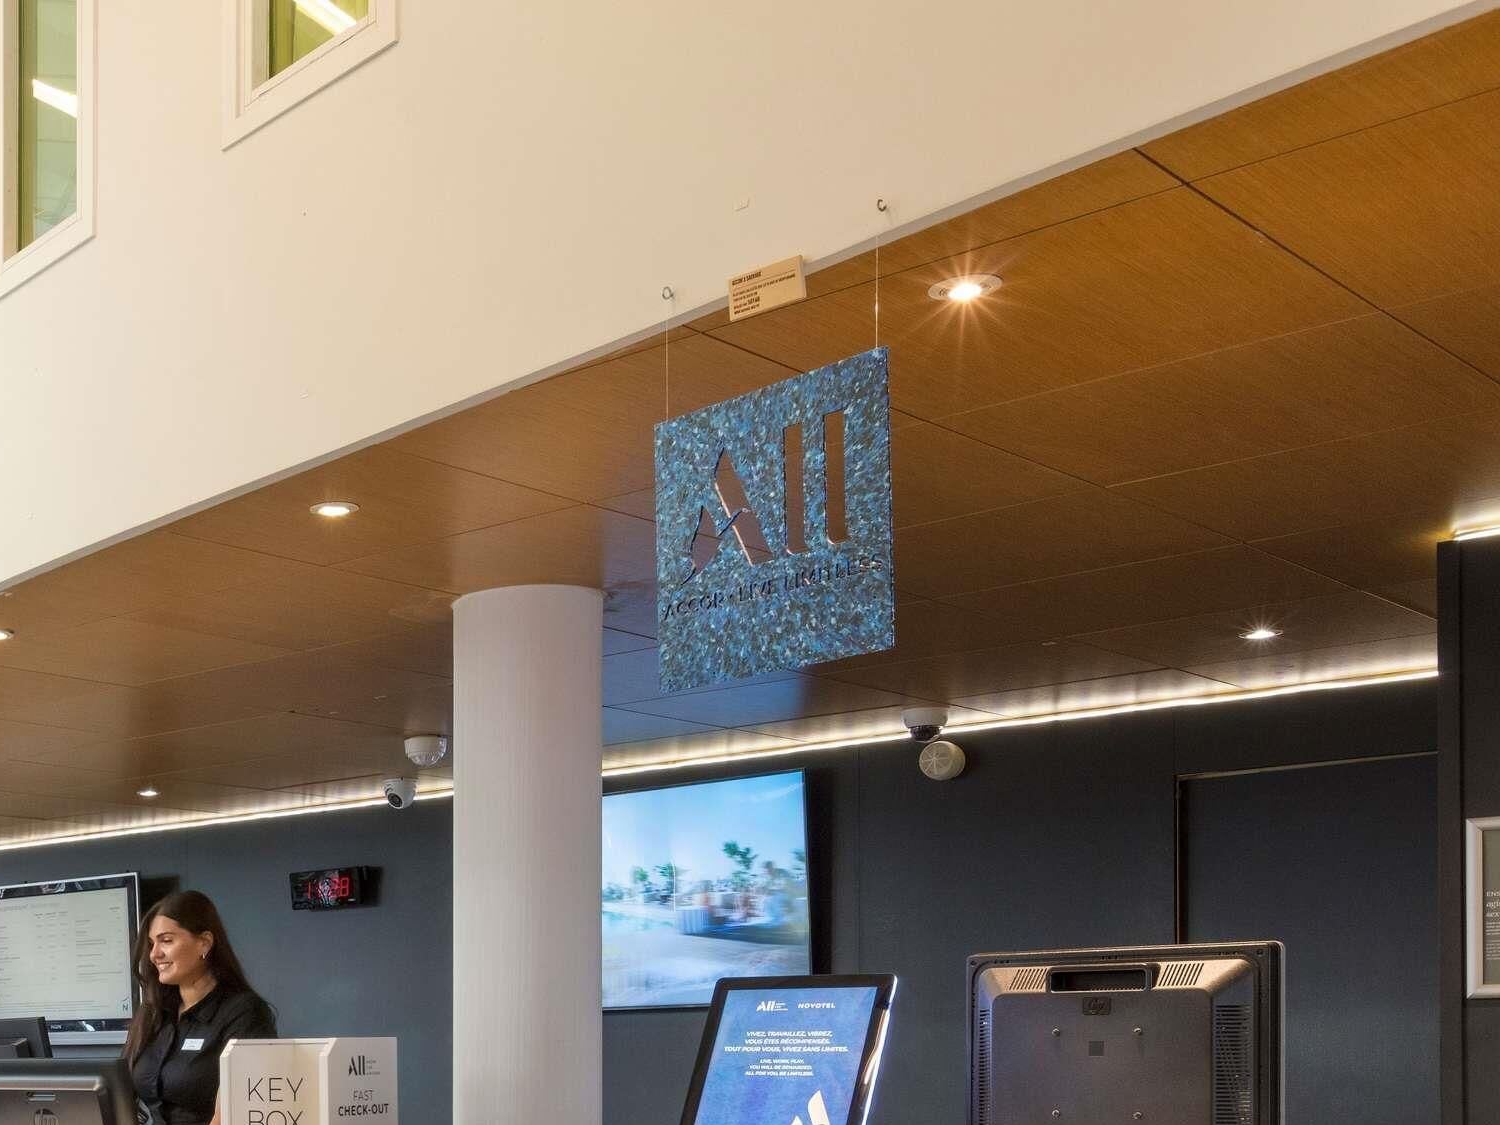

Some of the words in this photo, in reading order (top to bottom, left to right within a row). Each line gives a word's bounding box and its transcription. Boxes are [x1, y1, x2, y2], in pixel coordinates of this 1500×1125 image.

[681, 408, 850, 585] All
[756, 1000, 776, 1012] All
[348, 1055, 366, 1076] All
[248, 1077, 304, 1102] KEY
[353, 1089, 375, 1101] FAST
[338, 1103, 389, 1117] CHECK-OUT
